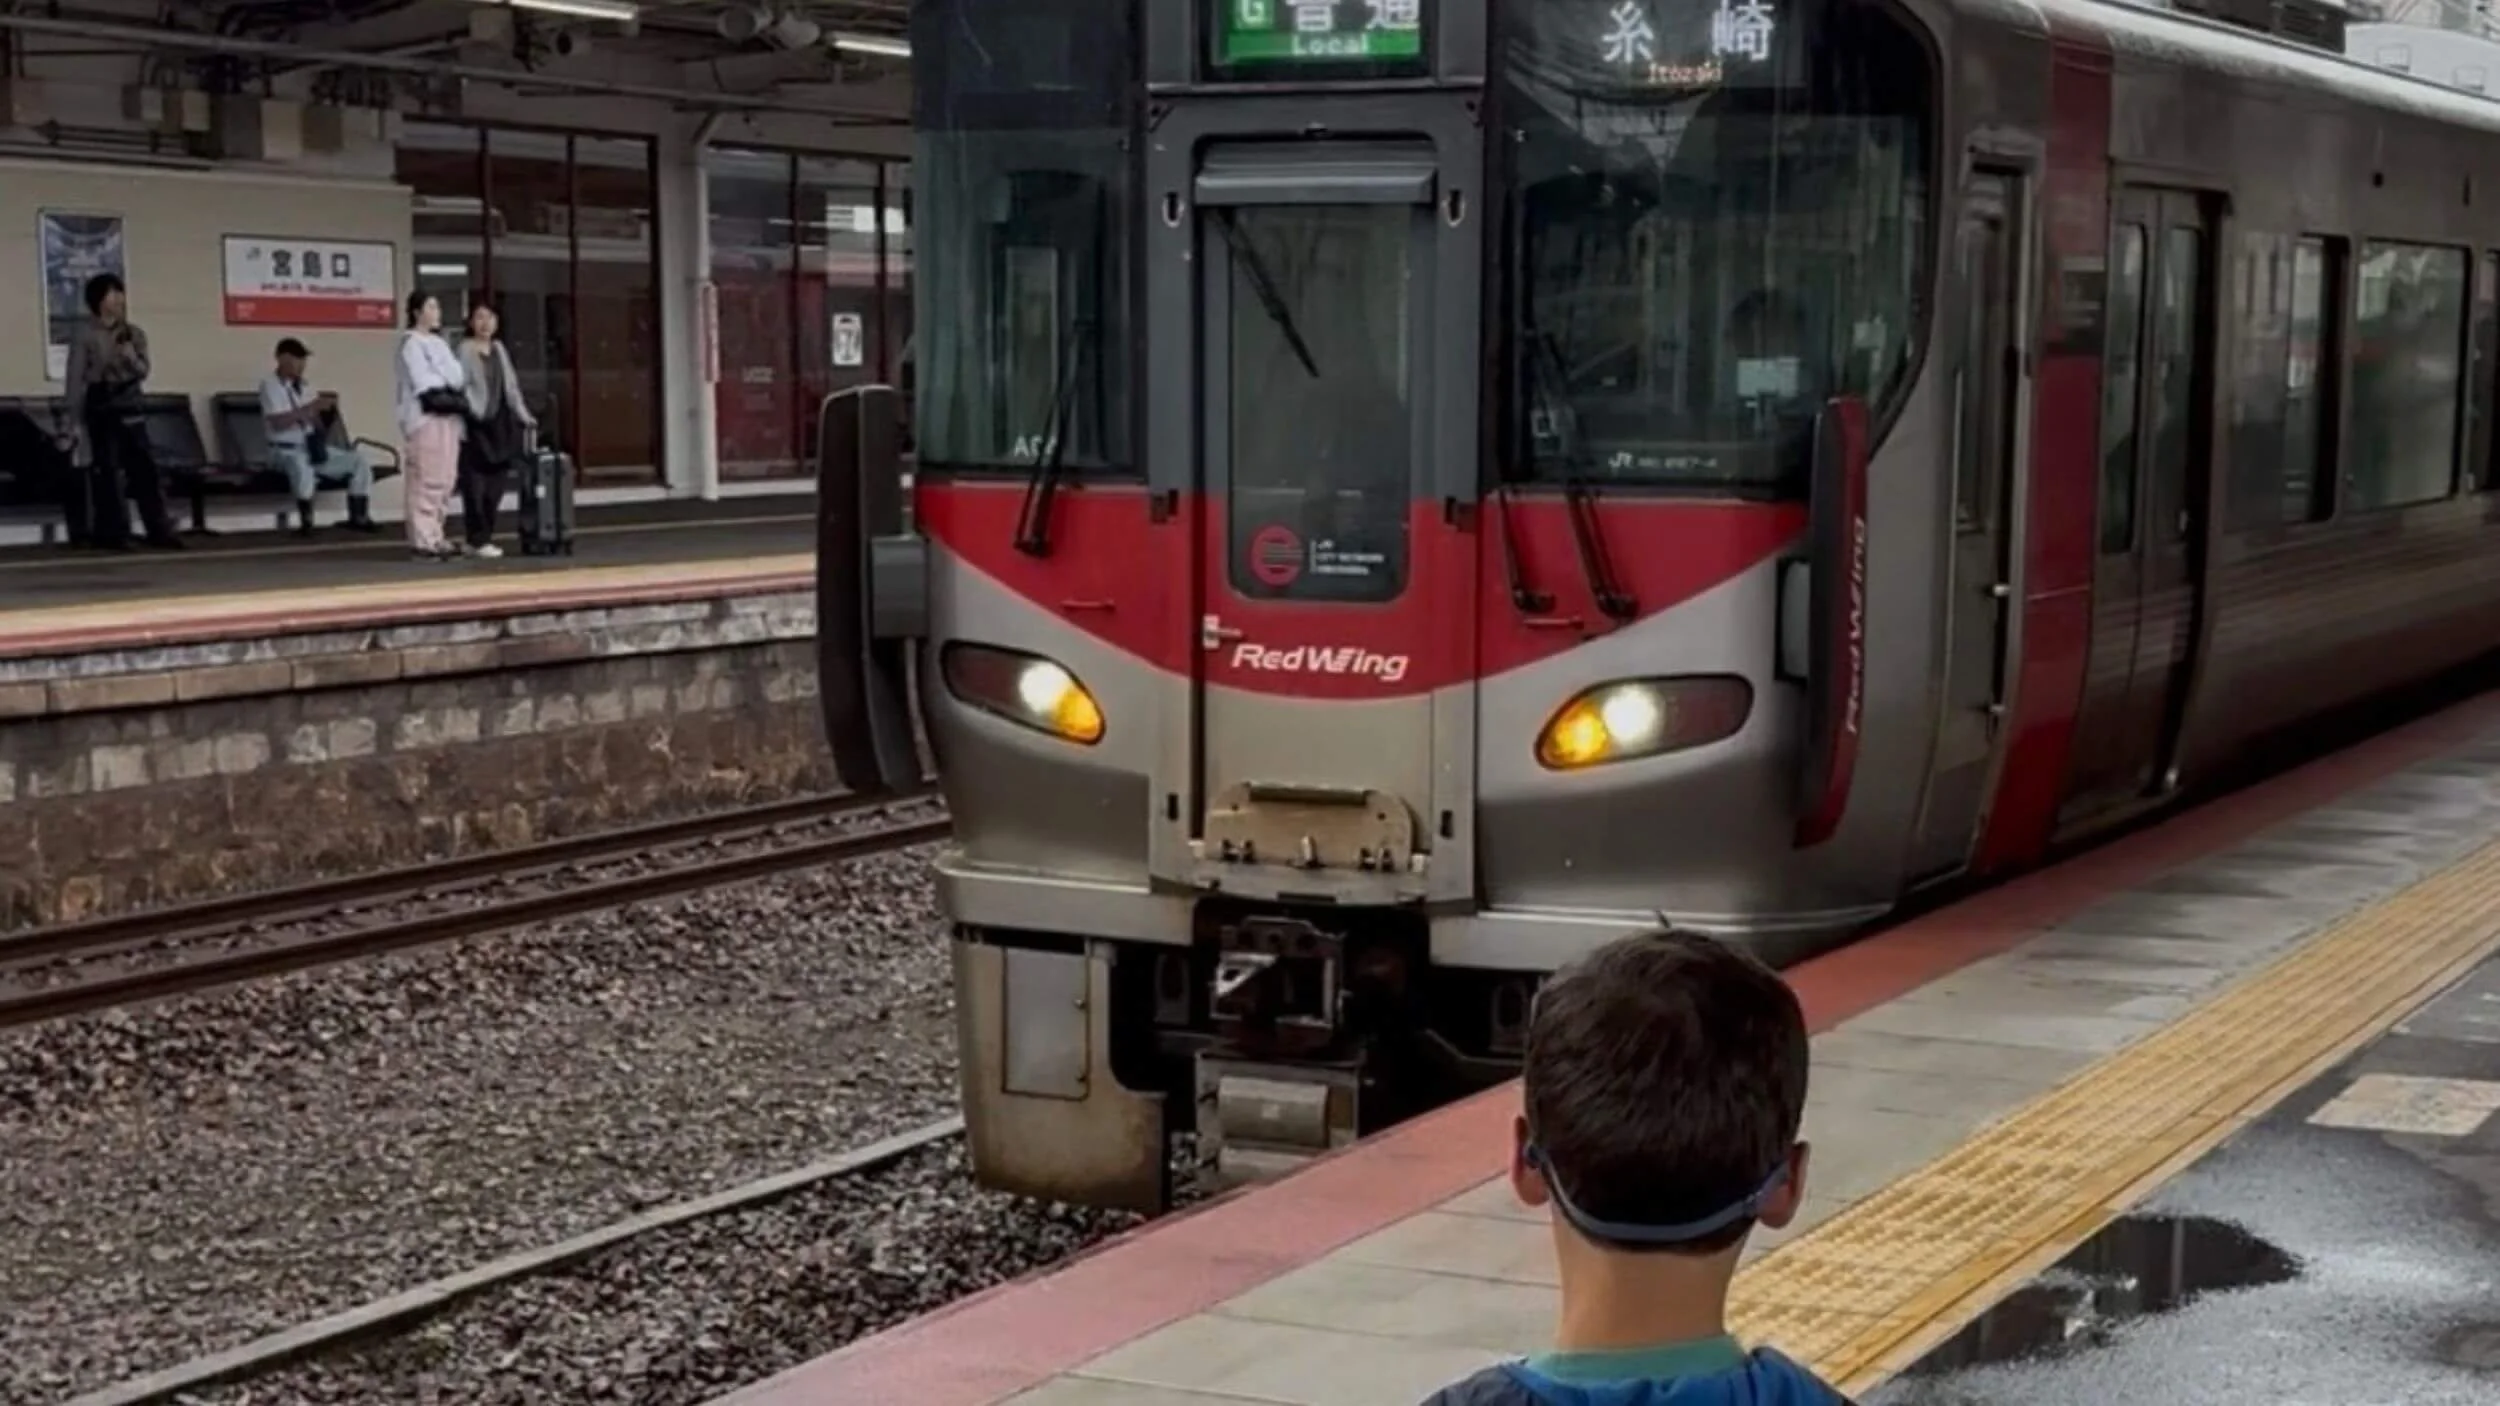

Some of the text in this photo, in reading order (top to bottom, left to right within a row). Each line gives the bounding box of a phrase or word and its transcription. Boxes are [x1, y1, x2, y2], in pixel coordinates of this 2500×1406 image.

[1292, 33, 1367, 55] Local
[1602, 0, 1775, 61] 糸崎
[272, 250, 350, 278] 宮島口
[1231, 643, 1409, 681] RedWing
